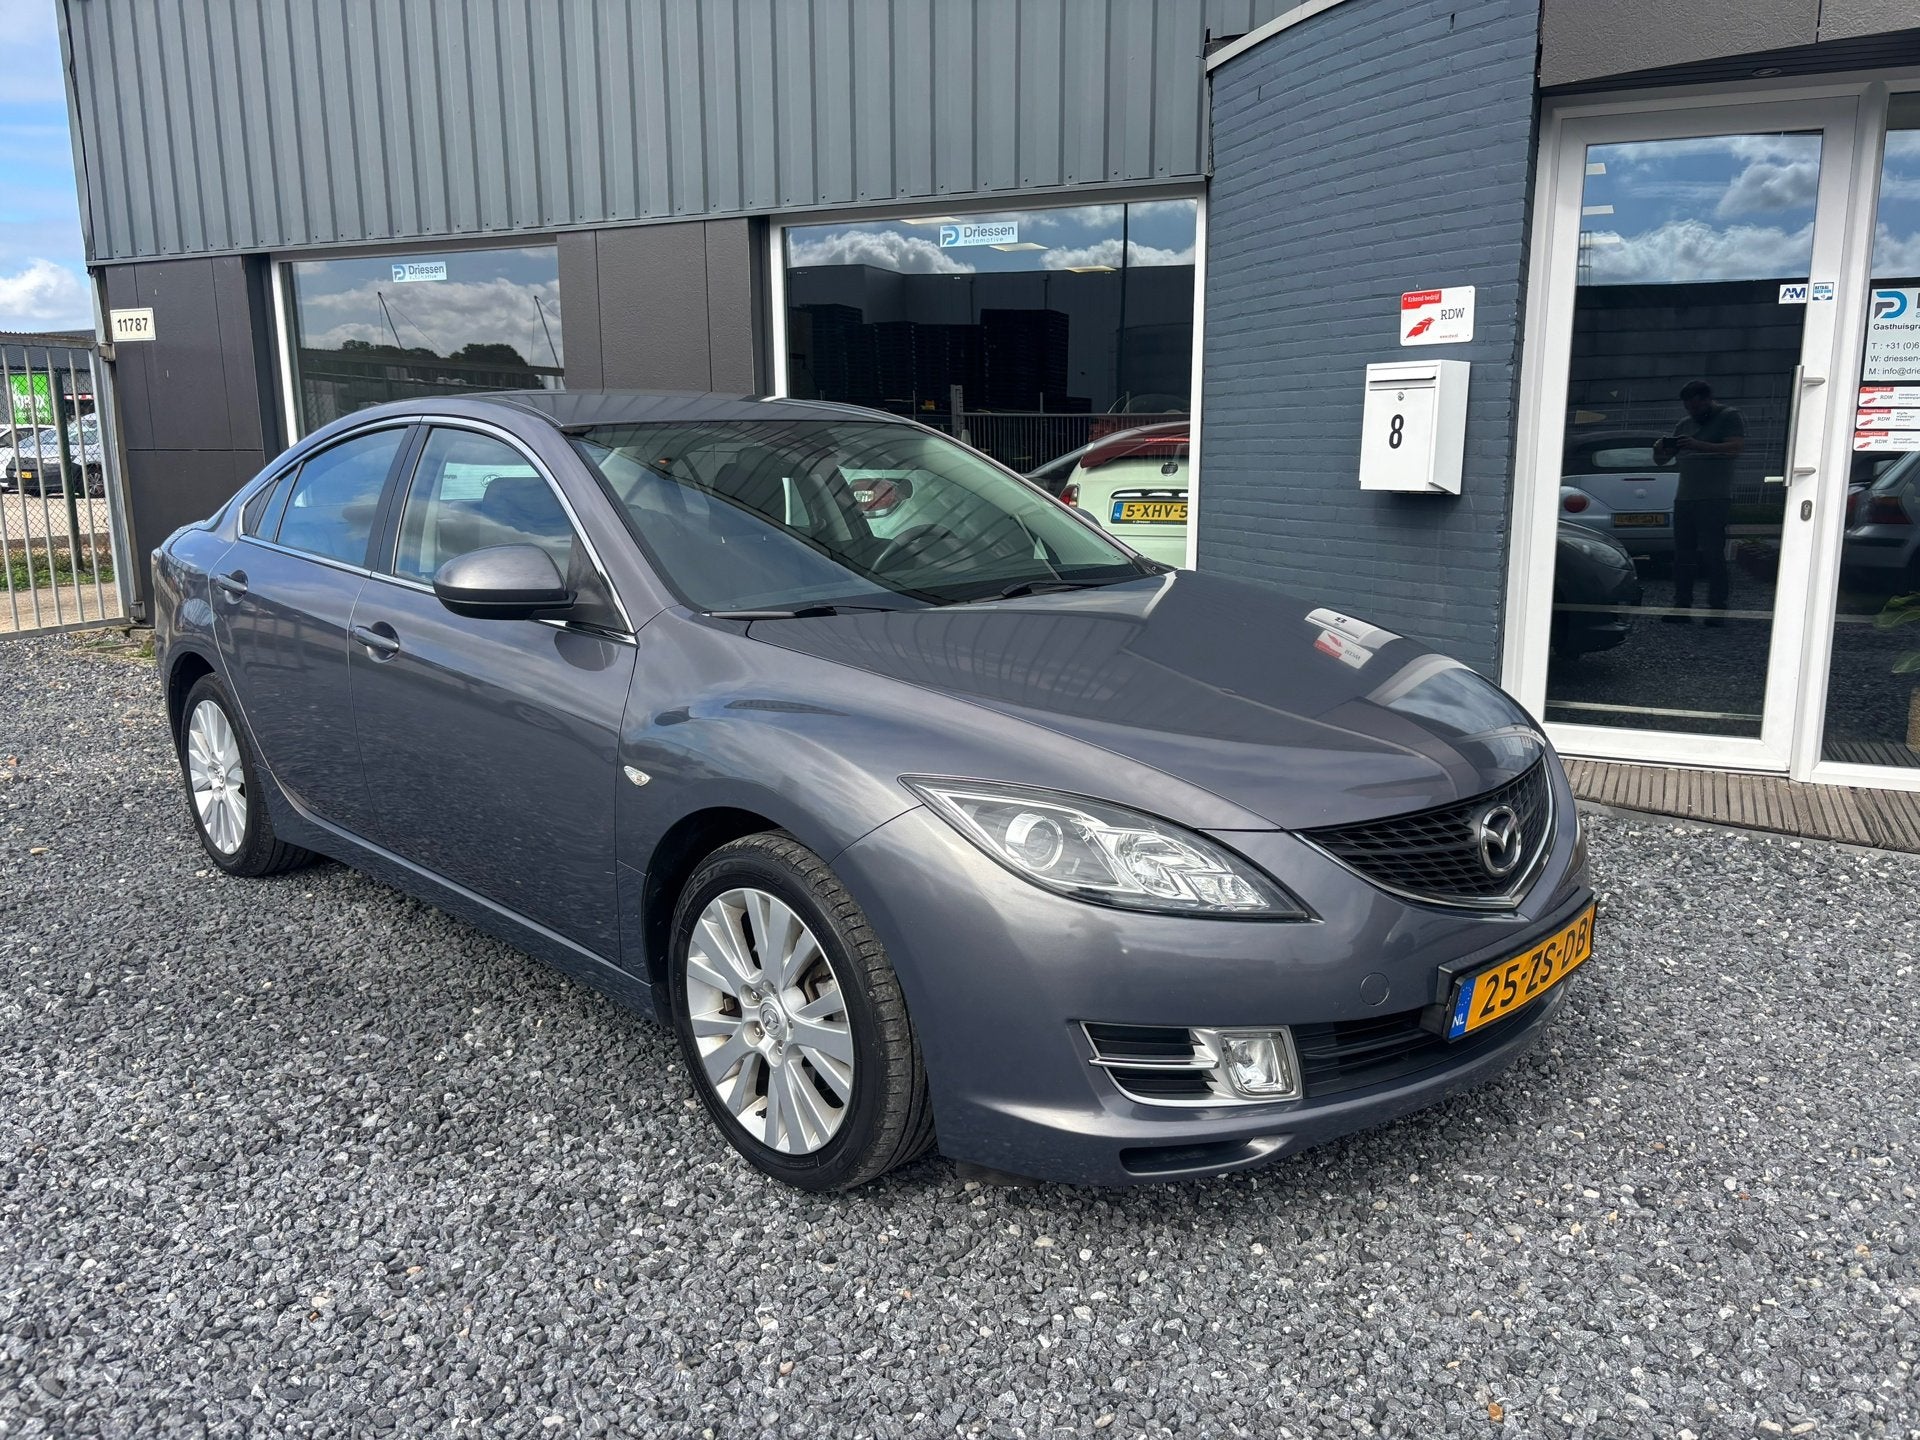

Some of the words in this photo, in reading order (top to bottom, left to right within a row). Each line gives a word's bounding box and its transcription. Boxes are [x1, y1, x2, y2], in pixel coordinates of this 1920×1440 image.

[963, 225, 1015, 238] Driessen
[963, 237, 1004, 245] automotive
[408, 264, 445, 275] Driessen
[1407, 295, 1424, 303] Erkend
[1424, 293, 1440, 302] bedrijf
[1440, 307, 1465, 321] RDW
[117, 317, 148, 332] 11787
[1885, 342, 1900, 350] +31
[1388, 413, 1405, 450] 8
[1126, 504, 1188, 518] 5-XHV-5
[1479, 917, 1588, 1019] 25-ZS-DB
[1451, 1013, 1465, 1028] NL
